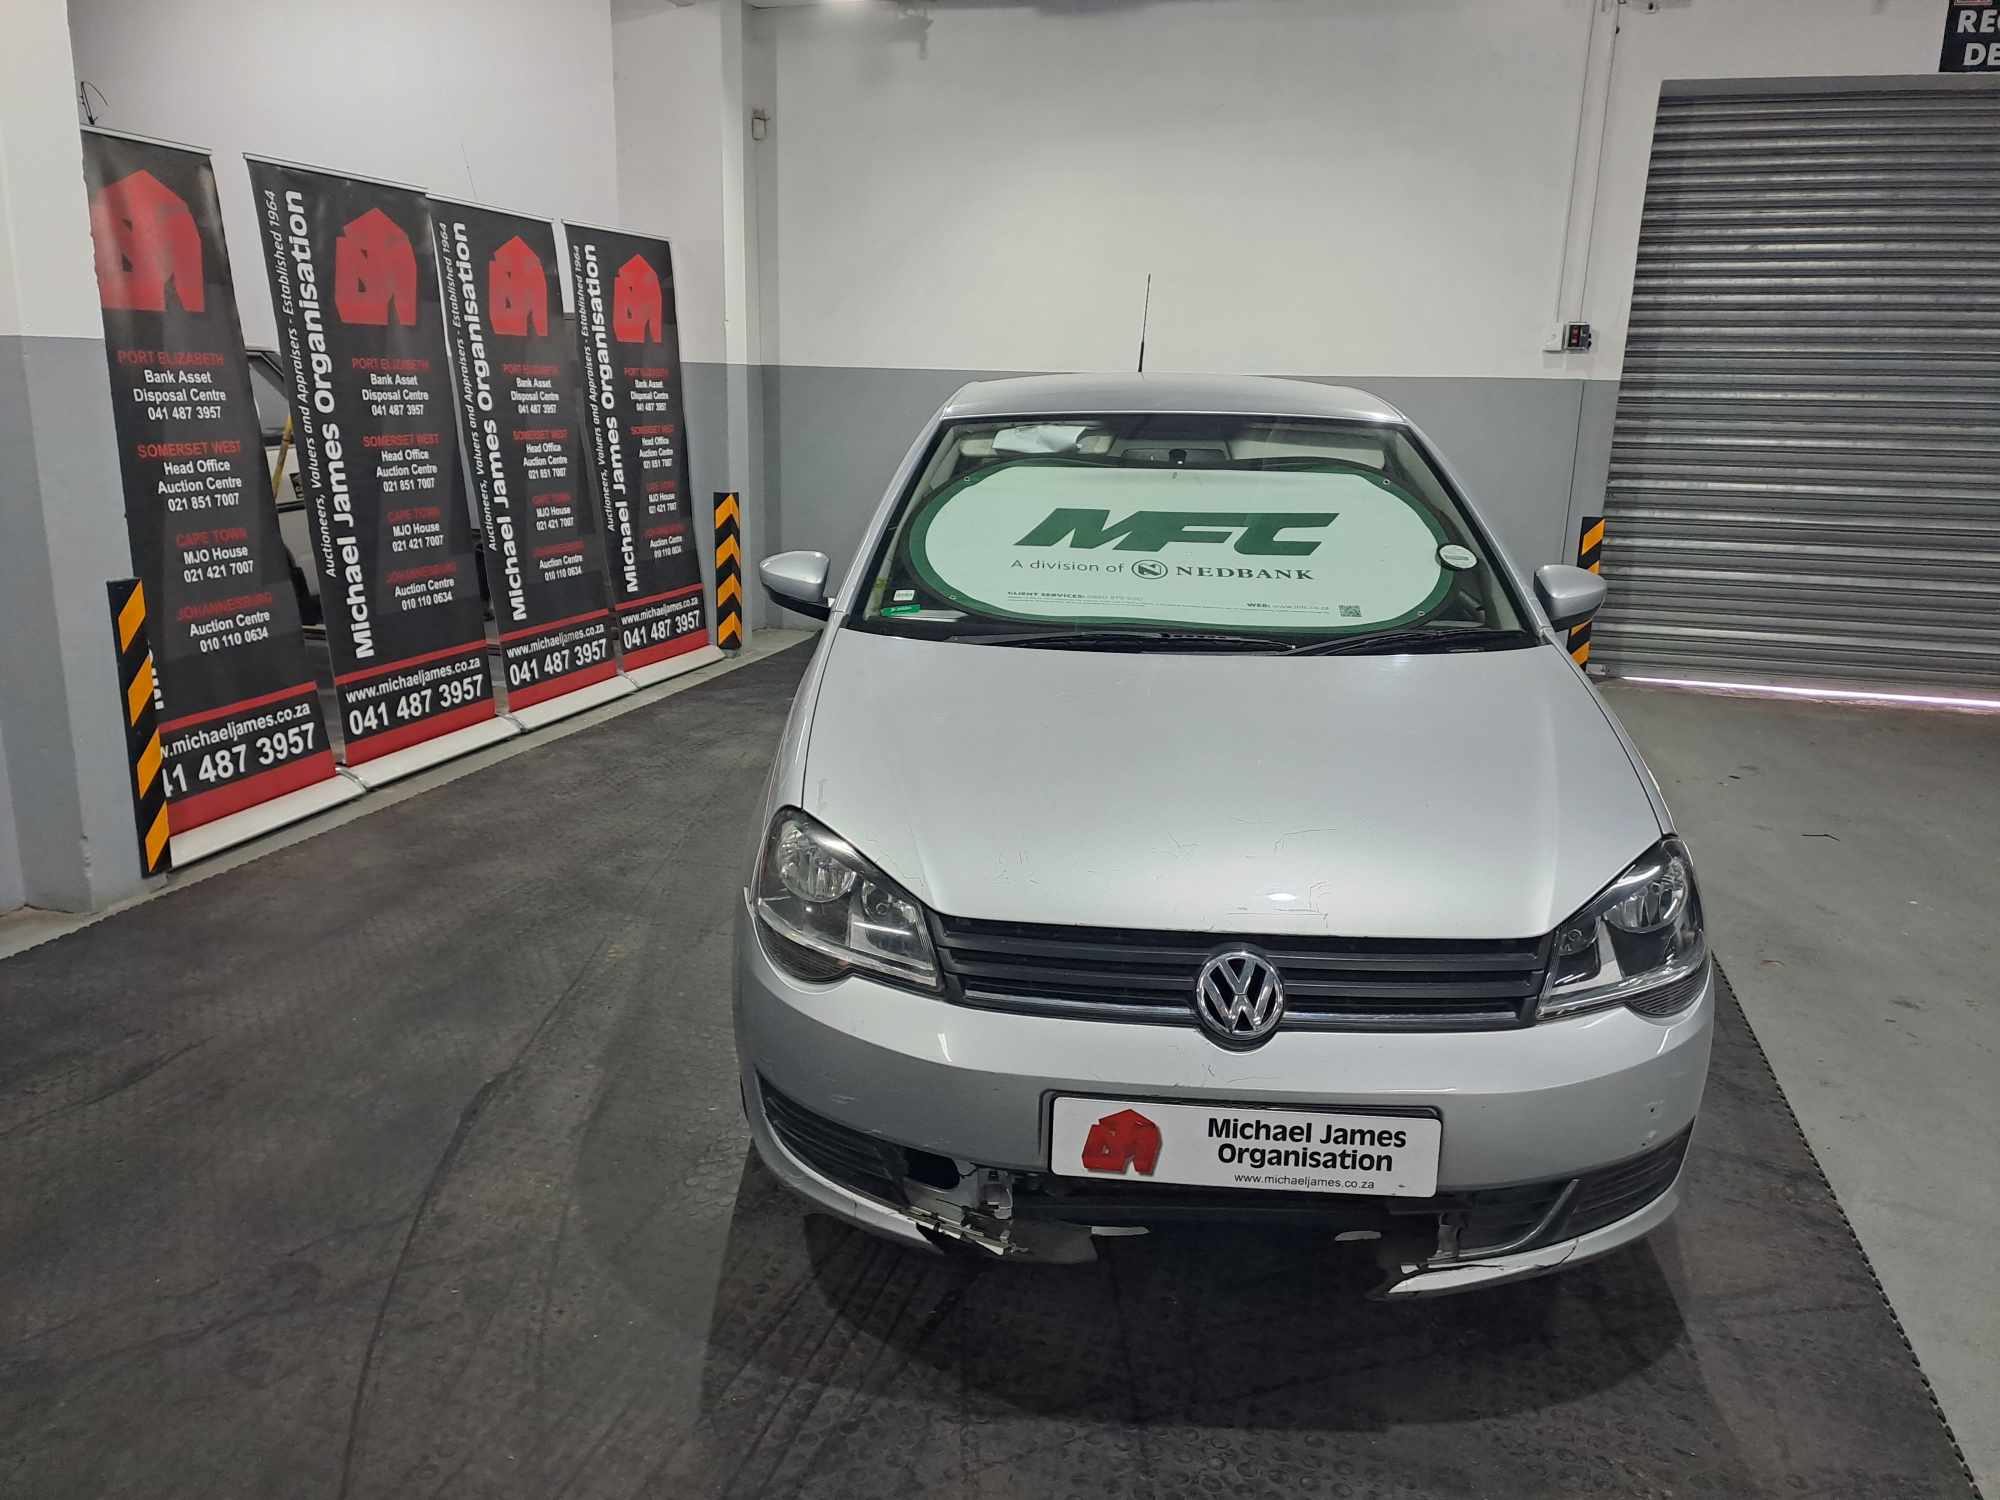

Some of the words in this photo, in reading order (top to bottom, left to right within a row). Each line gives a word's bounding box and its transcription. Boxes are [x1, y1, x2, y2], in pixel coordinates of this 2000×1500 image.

[1957, 9, 2000, 33] RE
[264, 189, 281, 227] 1964
[439, 222, 450, 253] 1964
[269, 230, 294, 316] Established
[285, 190, 335, 414] Organisation
[443, 255, 462, 328] Established
[575, 274, 589, 337] Established
[453, 222, 493, 412] Organisation
[584, 244, 615, 410] Organisation
[117, 350, 154, 365] PORT
[288, 327, 310, 404] Appraisers
[456, 338, 473, 403] Appraisers
[144, 369, 176, 383] Bank
[178, 370, 213, 383] Asset
[370, 373, 393, 386] Bank
[395, 374, 418, 386] Asset
[133, 388, 187, 404] Disposal
[190, 388, 226, 401] Centre
[362, 389, 401, 402] Disposal
[402, 389, 429, 400] Centre
[371, 404, 386, 416] 041
[388, 404, 404, 416] 487
[406, 404, 424, 415] 3957
[148, 406, 169, 420] 041
[172, 406, 192, 420] 487
[195, 405, 221, 419] 3957
[298, 404, 313, 434] and
[465, 404, 477, 429] and
[137, 442, 208, 458] SOMERSET
[211, 440, 241, 454] WEST
[381, 450, 402, 462] Head
[404, 448, 429, 460] Office
[471, 431, 484, 475] Valuers
[542, 442, 561, 452] Office
[594, 427, 606, 465] Valuers
[606, 416, 626, 495] James
[163, 461, 194, 475] Head
[196, 459, 231, 473] Office
[303, 437, 322, 489] Valuers
[322, 423, 354, 527] James
[376, 465, 410, 478] Auction
[411, 463, 438, 475] Centre
[483, 419, 509, 509] James
[523, 457, 547, 467] Auction
[158, 479, 204, 495] Auction
[206, 476, 242, 490] Centre
[383, 480, 398, 492] 021
[400, 479, 415, 491] 851
[417, 477, 435, 489] 7007
[168, 497, 188, 512] 021
[191, 495, 212, 509] 851
[214, 493, 240, 507] 7007
[480, 479, 497, 551] Auctioneers,
[550, 506, 571, 516] House
[315, 493, 336, 577] Auctioneers,
[392, 524, 412, 537] MJO
[412, 522, 440, 535] House
[392, 540, 407, 552] 021
[408, 538, 423, 549] 421
[424, 534, 444, 547] 7007
[1012, 508, 1340, 556] MFC
[183, 549, 209, 565] MJO
[211, 546, 248, 560] House
[615, 500, 639, 593] Michael
[183, 568, 204, 583] 021
[206, 564, 227, 579] 421
[229, 560, 254, 576] 7007
[496, 516, 527, 621] Michael
[539, 558, 562, 569] Auction
[1011, 559, 1023, 569] A
[1030, 559, 1100, 573] division
[1106, 563, 1124, 573] of
[1176, 566, 1314, 580] NEDBANK
[336, 536, 375, 659] Michael
[394, 583, 427, 597] Auction
[427, 578, 455, 590] Centre
[401, 598, 416, 611] 010
[418, 595, 431, 607] 110
[433, 591, 453, 604] 0634
[190, 618, 234, 637] Auction
[236, 611, 271, 627] Centre
[623, 626, 647, 650] 041
[651, 618, 671, 640] 487
[675, 610, 700, 634] 3957
[200, 636, 220, 653] 010
[221, 632, 242, 648] 110
[244, 626, 269, 643] 0634
[507, 624, 604, 659] www.michaeljames.co.za
[509, 658, 539, 686] 041
[544, 649, 570, 675] 487
[574, 638, 607, 666] 3957
[346, 657, 480, 703] www.michaeljames.co.za
[349, 702, 390, 735] 041
[397, 688, 432, 720] 487
[439, 674, 483, 708] 3957
[198, 743, 248, 783] 487
[256, 722, 315, 766] 3957
[1207, 1116, 1312, 1144] Michael
[1319, 1124, 1407, 1148] James
[1217, 1141, 1393, 1173] Organisation
[1234, 1173, 1375, 1190] www.michaeljames.co.za
